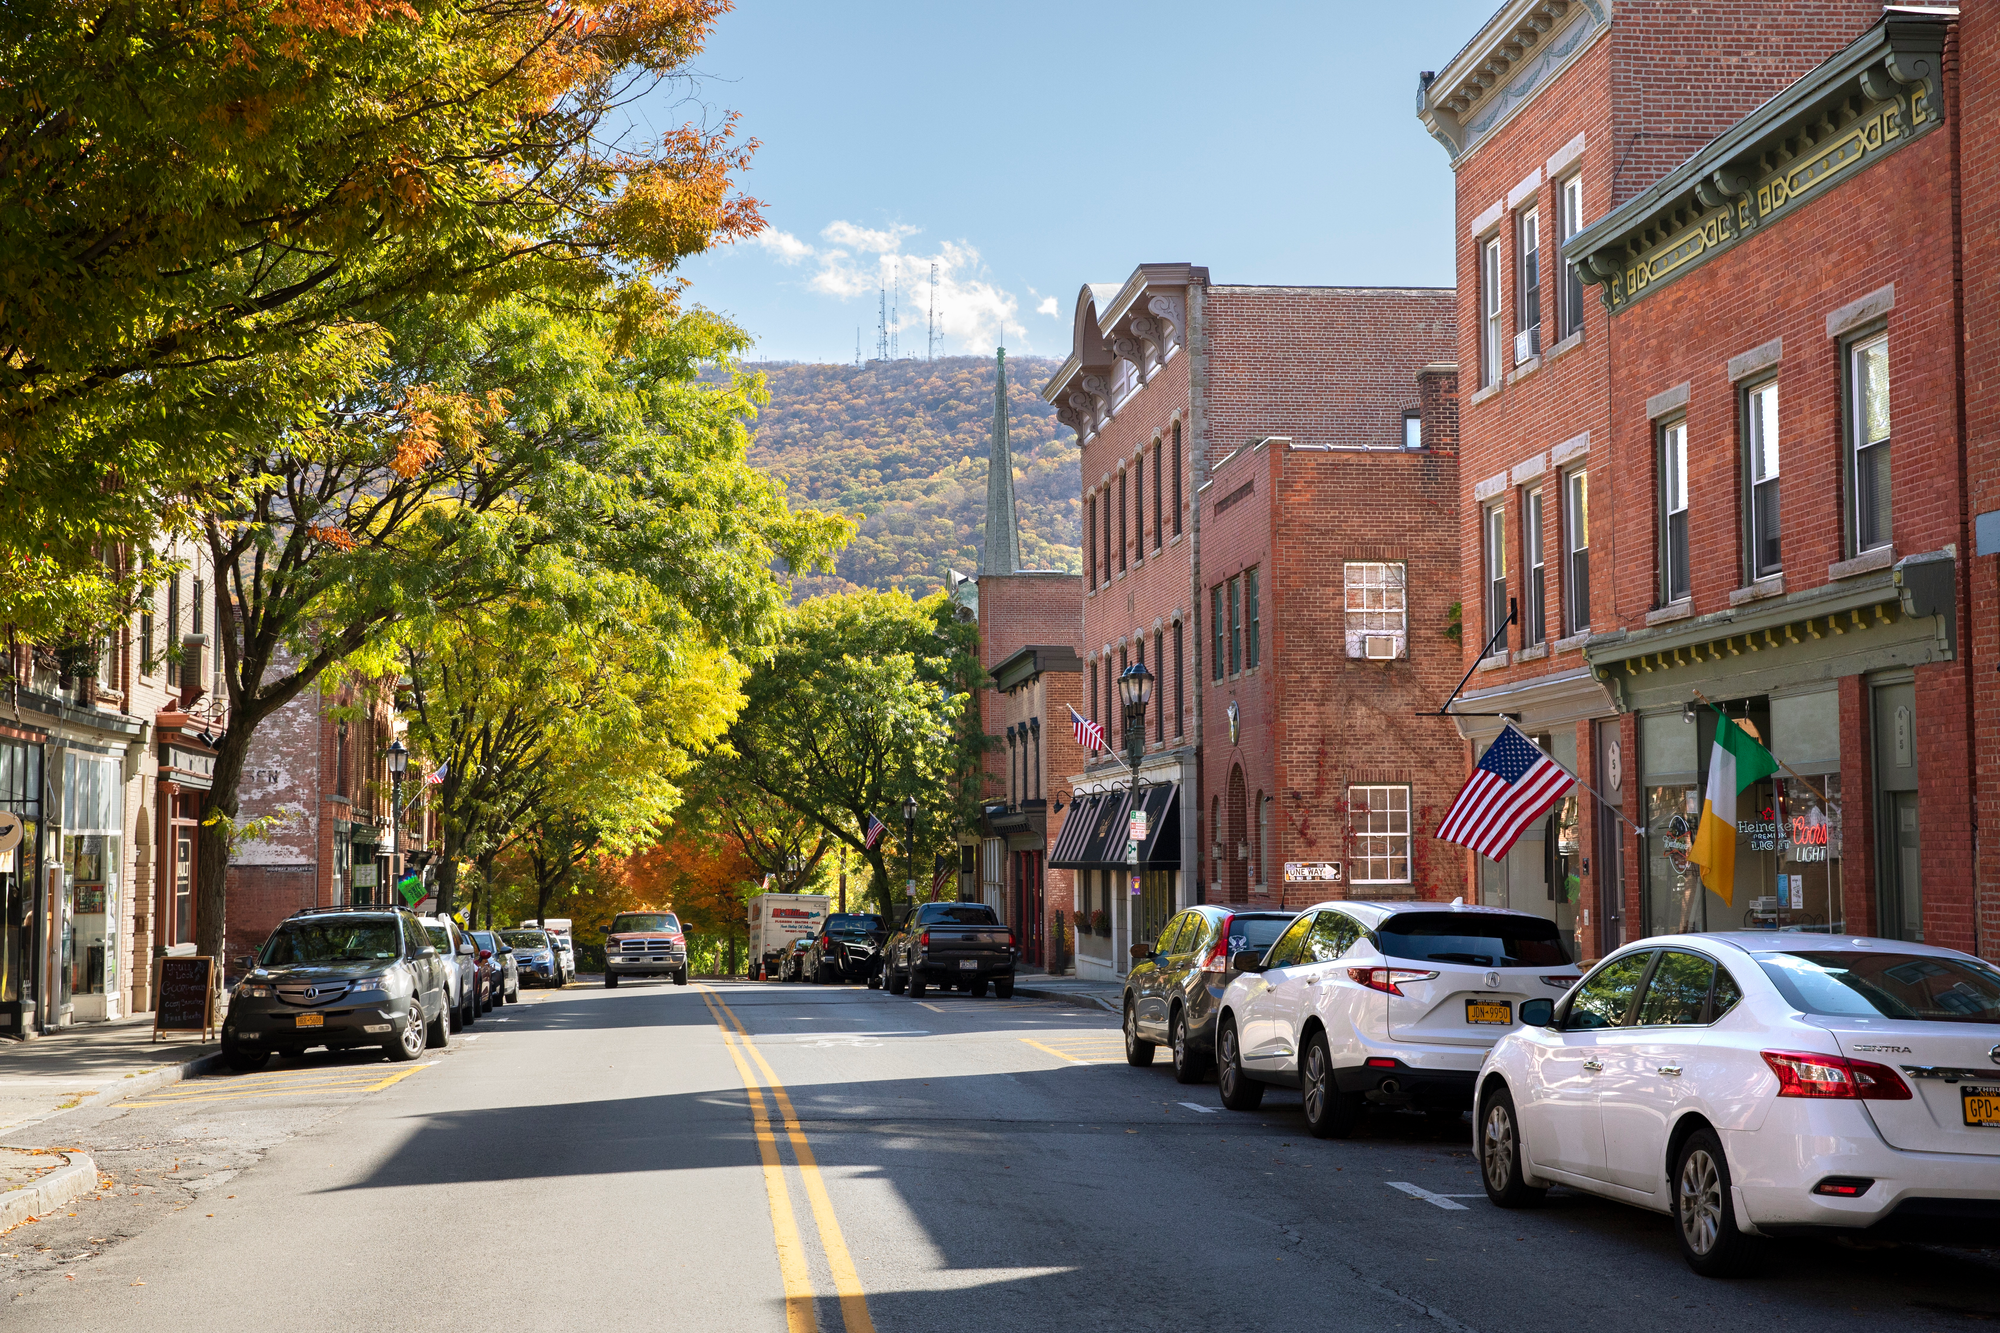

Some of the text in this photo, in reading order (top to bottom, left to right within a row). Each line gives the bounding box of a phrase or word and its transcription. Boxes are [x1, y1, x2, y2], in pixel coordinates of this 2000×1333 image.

[1792, 815, 1827, 845] Coors
[1362, 843, 1392, 852] OPEN
[1796, 846, 1827, 862] LIGHT
[1853, 1044, 1912, 1053] SENTRA
